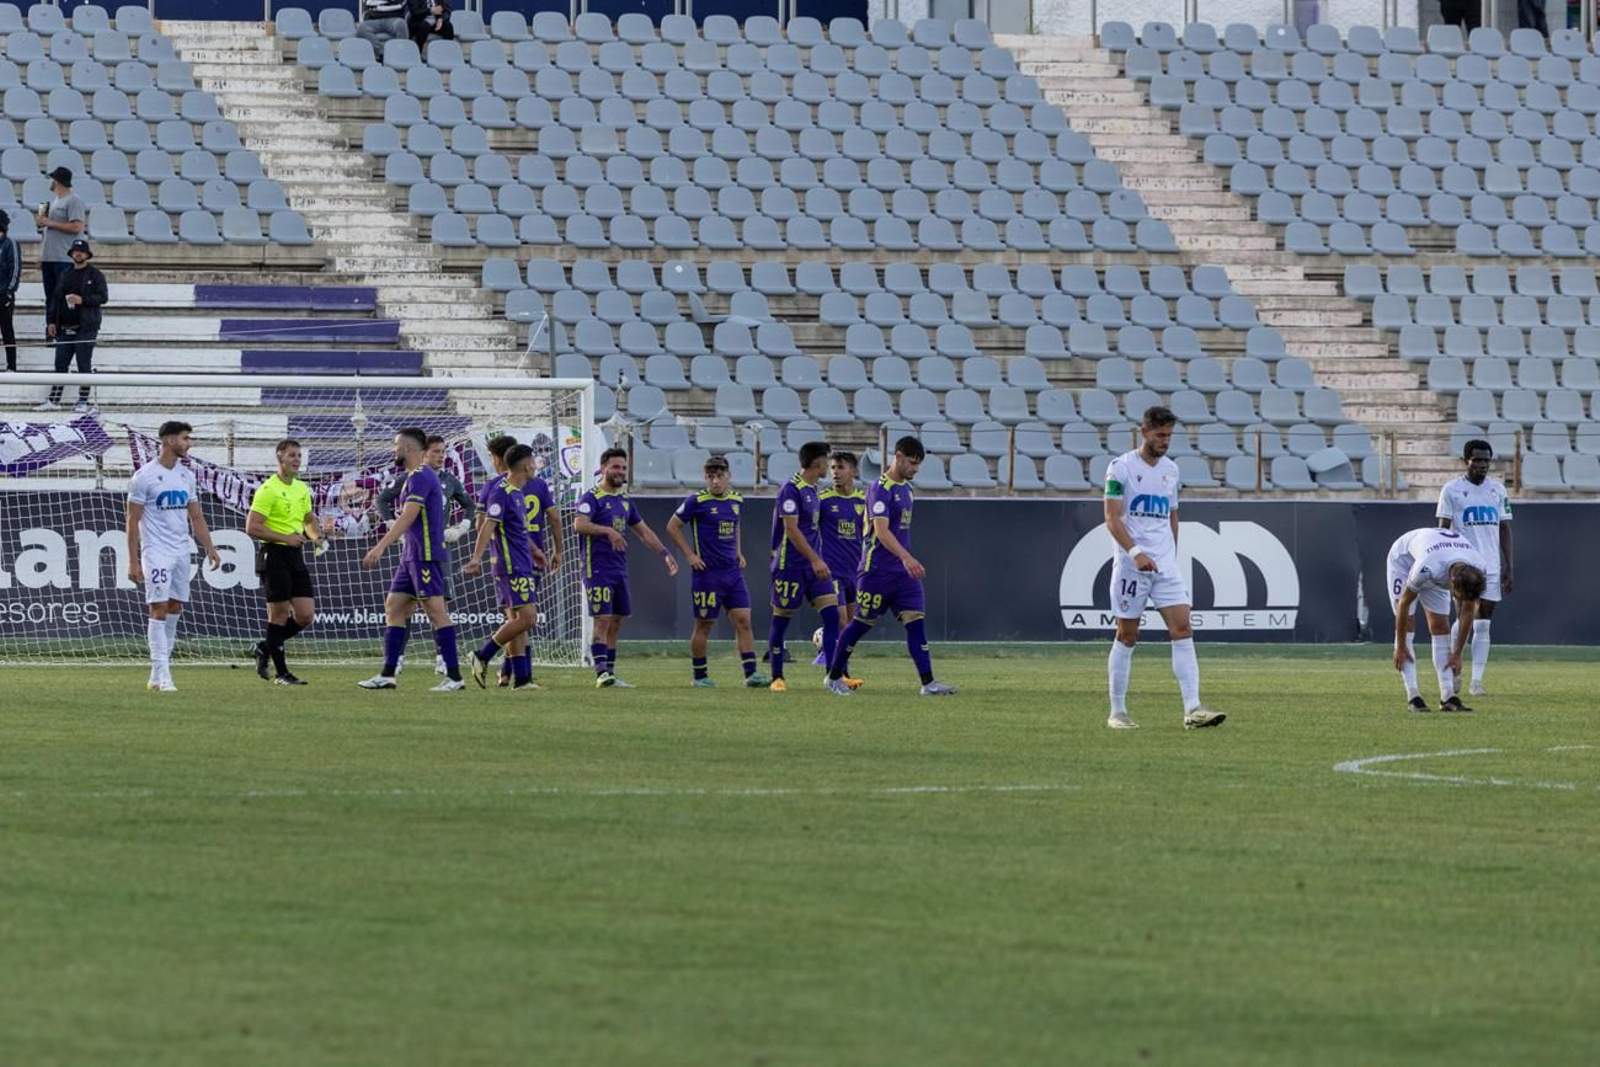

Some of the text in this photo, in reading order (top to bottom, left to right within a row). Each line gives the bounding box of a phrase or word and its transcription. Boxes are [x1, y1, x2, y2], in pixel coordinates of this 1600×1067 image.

[151, 568, 168, 584] 25
[593, 585, 611, 603] 30
[783, 580, 800, 598] 17
[1121, 579, 1137, 598] 14
[1393, 578, 1403, 595] 6
[700, 591, 716, 608] 14
[862, 592, 882, 609] 29
